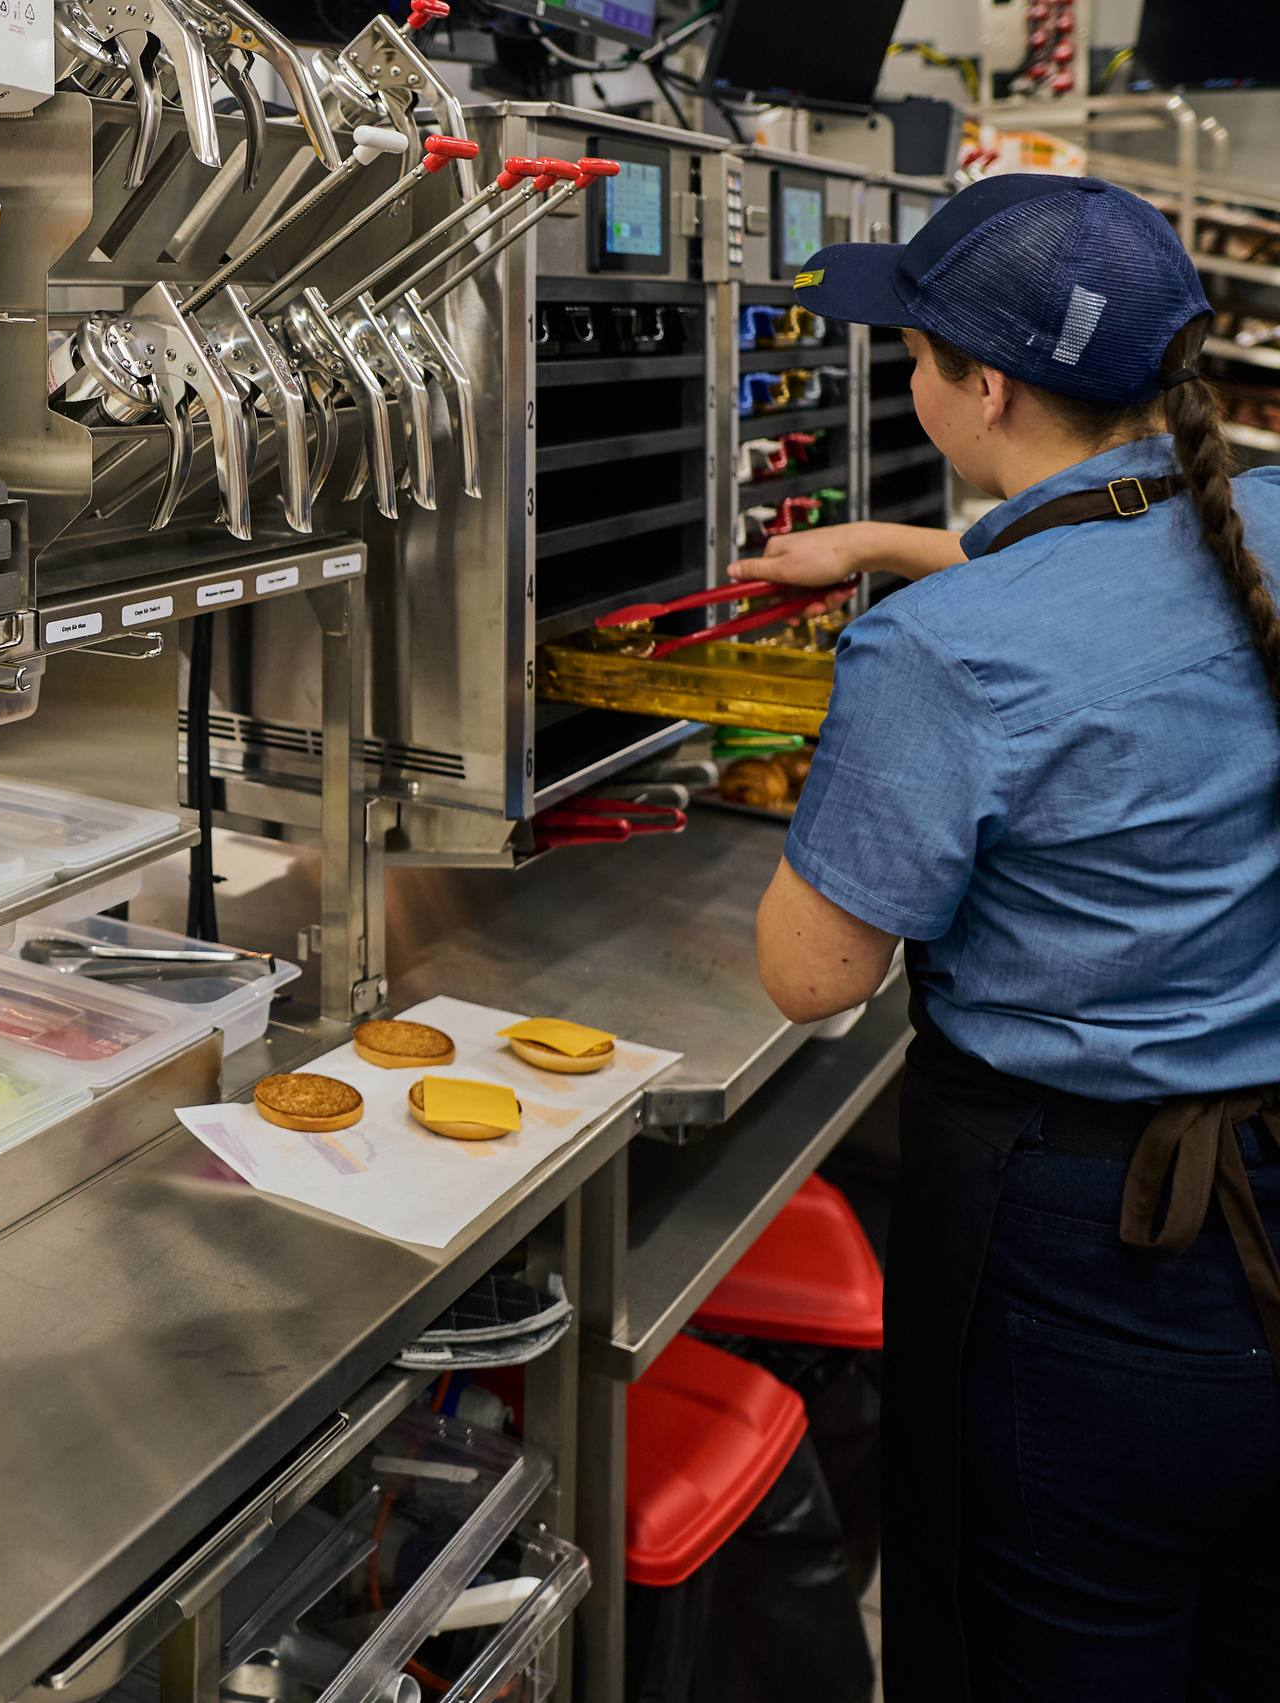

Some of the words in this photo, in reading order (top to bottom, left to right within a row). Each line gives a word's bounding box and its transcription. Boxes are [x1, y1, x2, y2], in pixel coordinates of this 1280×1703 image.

[528, 313, 533, 342] 1
[527, 400, 534, 430] 2
[527, 488, 534, 517] 3
[527, 574, 534, 603] 4
[526, 661, 534, 690] 5
[526, 749, 533, 778] 6
